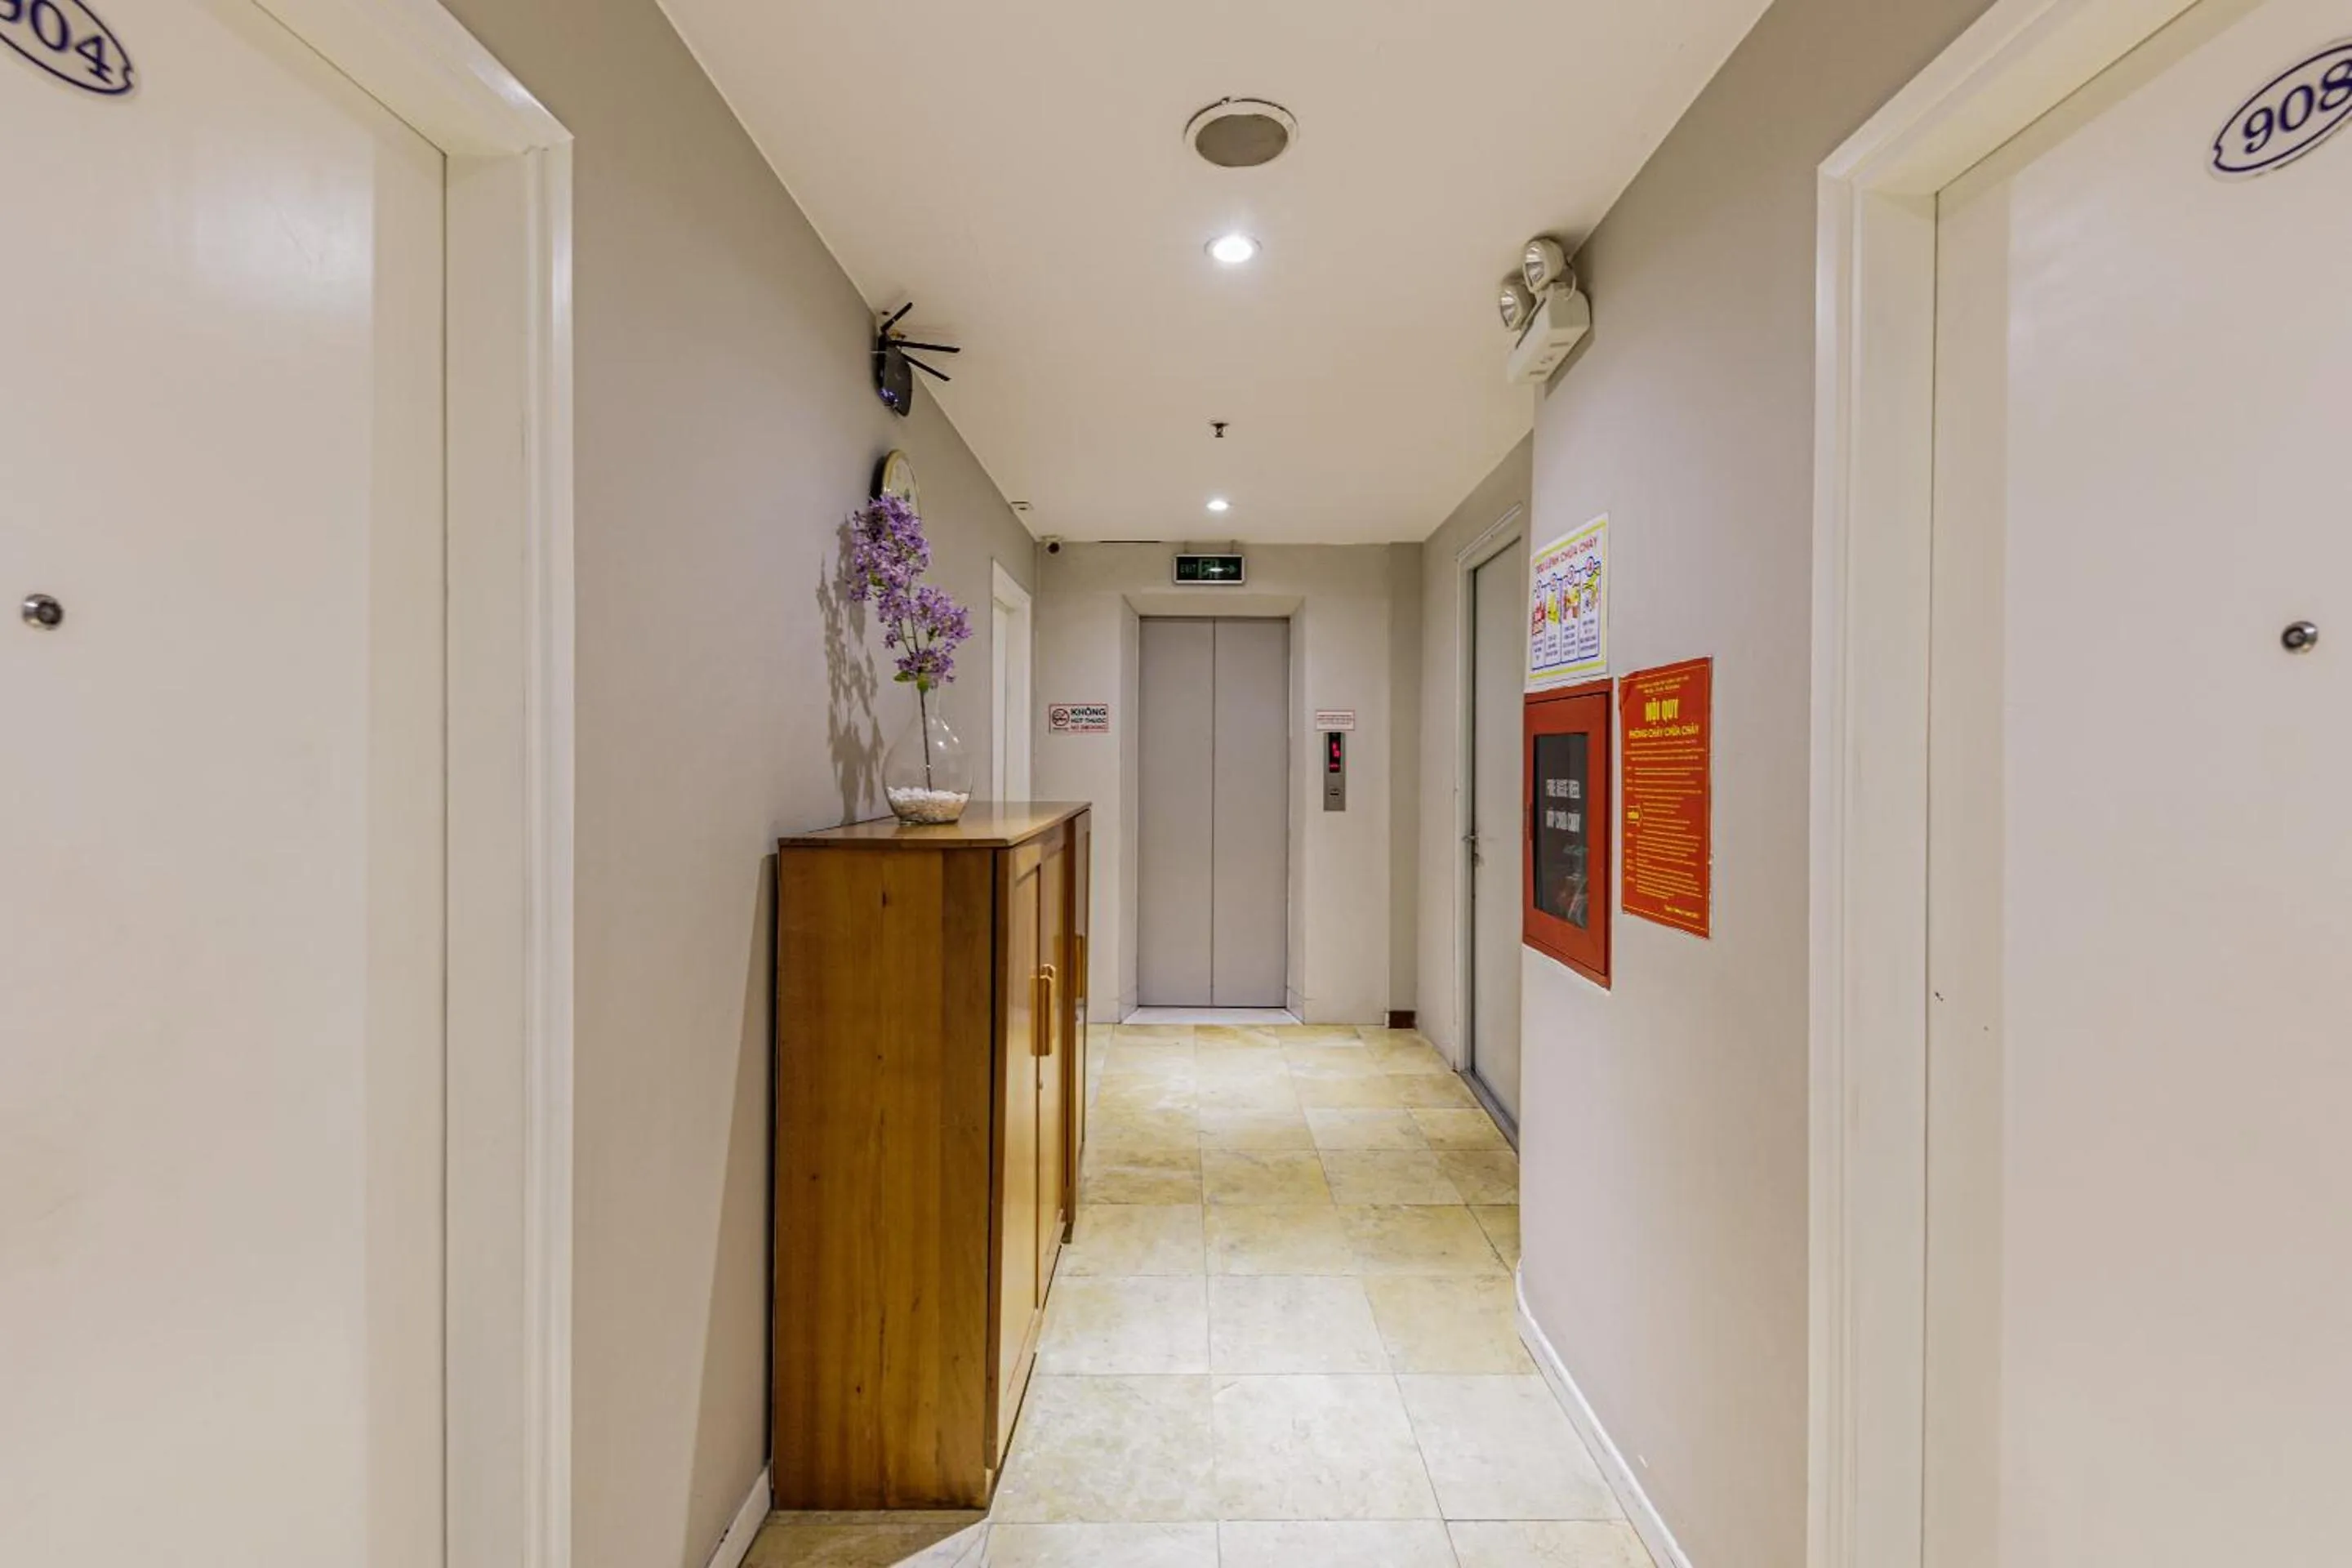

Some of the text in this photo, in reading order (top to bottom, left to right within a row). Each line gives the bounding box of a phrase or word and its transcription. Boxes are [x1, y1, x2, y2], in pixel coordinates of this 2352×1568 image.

[2243, 59, 2352, 154] 908
[1180, 564, 1196, 573] EXIT
[1071, 706, 1106, 715] KHÔNG
